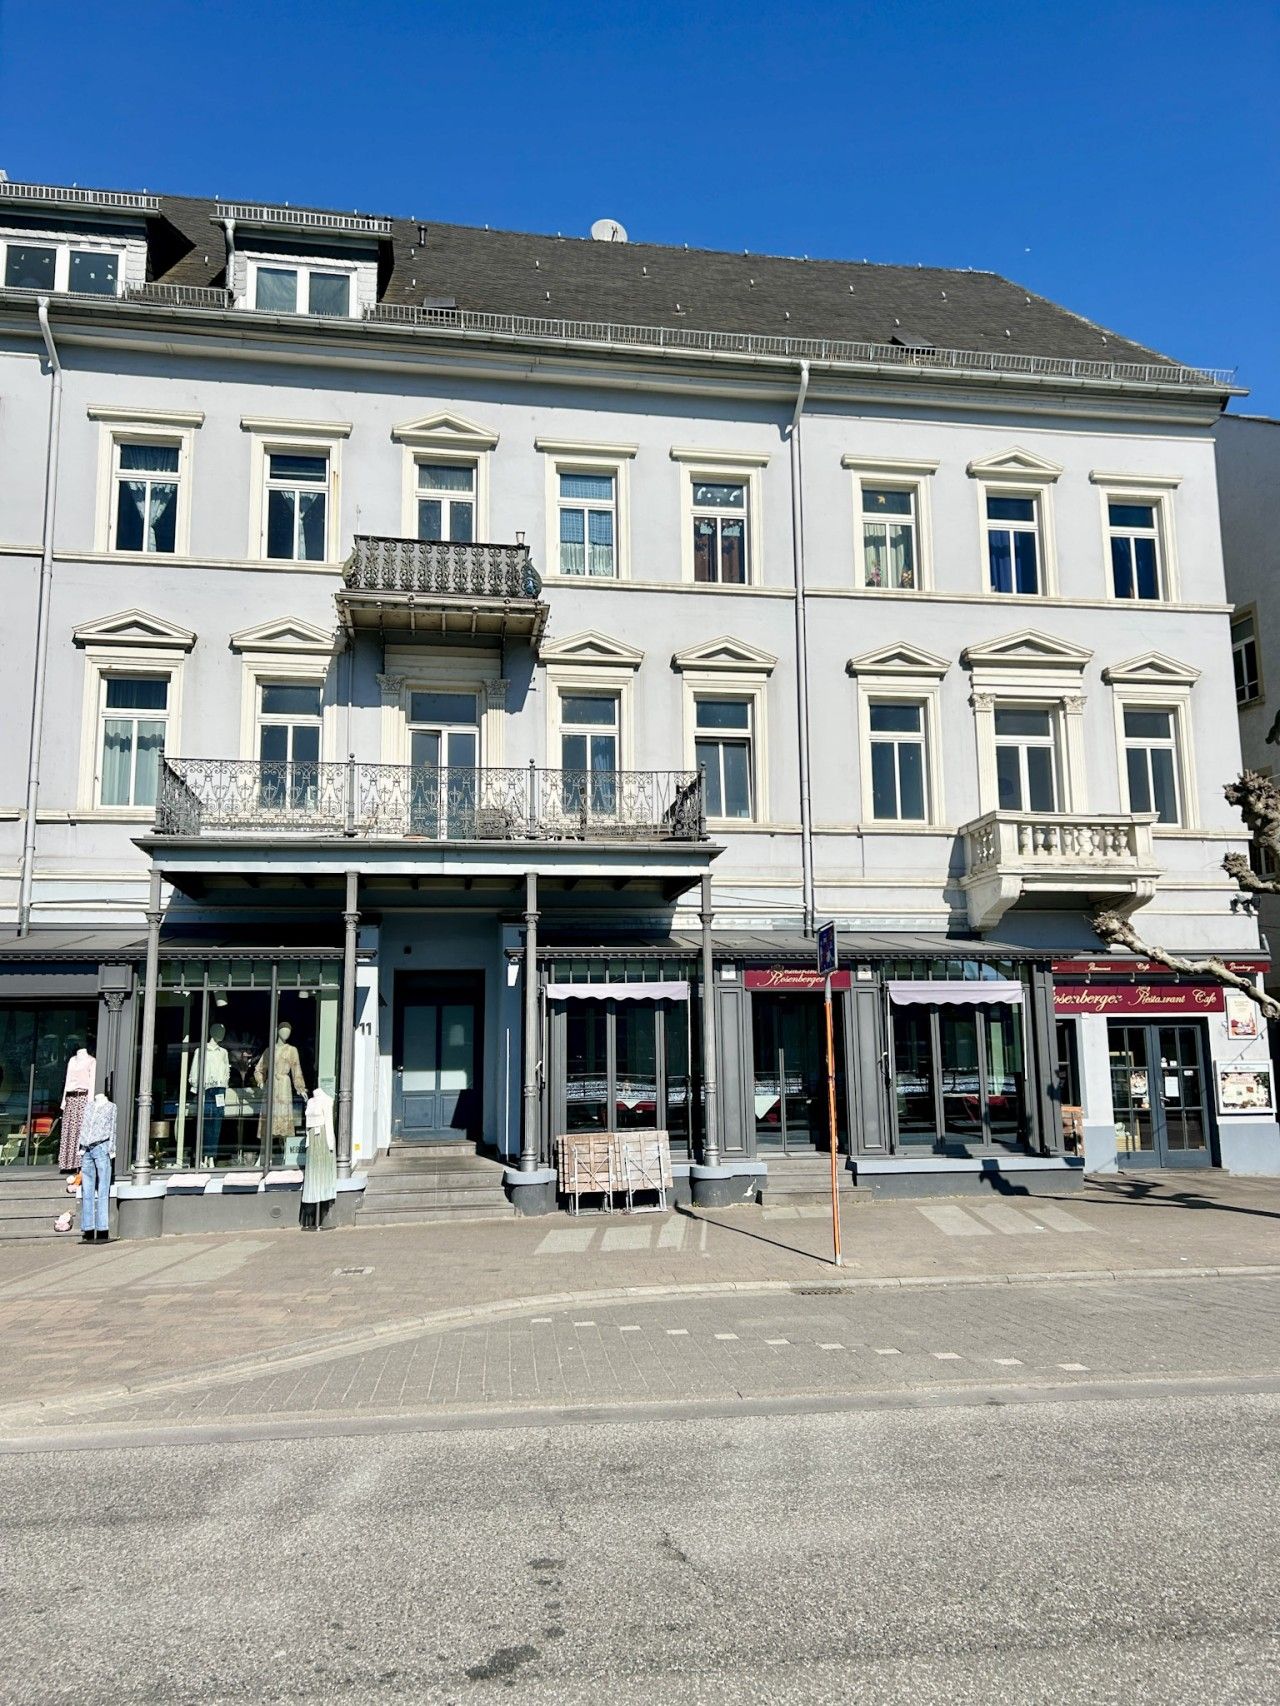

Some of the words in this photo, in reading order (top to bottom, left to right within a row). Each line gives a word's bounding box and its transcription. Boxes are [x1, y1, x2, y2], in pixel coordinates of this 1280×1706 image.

[756, 969, 825, 988] Rosenberger
[1052, 987, 1123, 1012] osenberger
[1127, 987, 1185, 1006] Restaurant
[1192, 989, 1217, 1007] Cafe
[360, 1022, 372, 1036] 11
